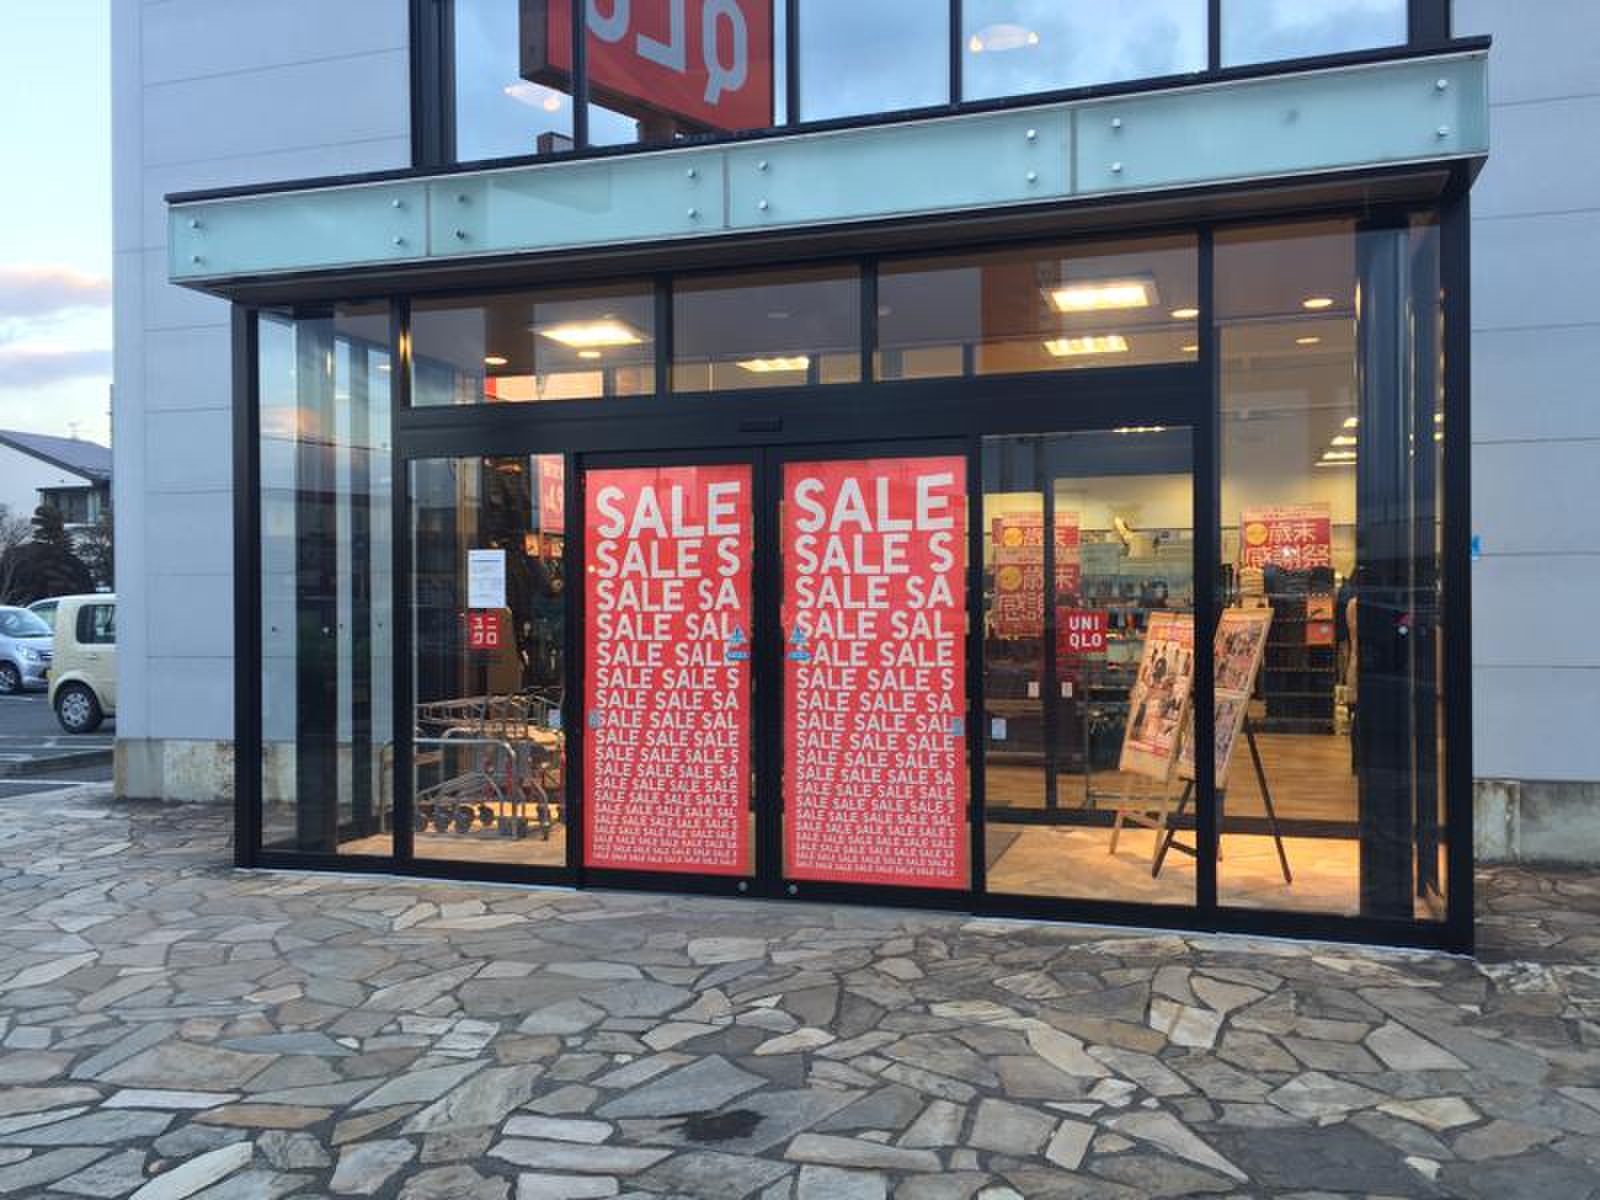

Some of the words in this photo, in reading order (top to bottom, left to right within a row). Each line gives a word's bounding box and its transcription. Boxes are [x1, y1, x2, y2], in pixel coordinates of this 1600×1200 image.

[596, 481, 739, 538] SALE
[795, 473, 953, 532] SALE
[595, 538, 701, 577] SALE
[717, 537, 740, 576] S
[795, 533, 909, 574] SALE
[929, 532, 953, 573] S
[596, 578, 684, 611] SALE
[698, 578, 740, 611] SA
[796, 575, 889, 608] SALE
[905, 575, 953, 608] SA
[596, 612, 672, 640] SALE
[685, 612, 737, 640] SAL
[797, 610, 877, 639] SALE
[891, 611, 953, 640] SAL
[1069, 615, 1099, 630] UNI
[1069, 632, 1102, 649] QLO
[597, 641, 663, 666] SALE
[880, 641, 953, 667] SALE
[596, 667, 652, 688] SALE
[662, 668, 716, 689] SALE
[726, 669, 738, 689] S
[797, 667, 856, 689] SALE
[867, 668, 930, 691] SALE
[941, 669, 953, 691] S
[595, 689, 646, 708] SALE
[655, 690, 703, 709] SALE
[711, 691, 737, 710] SA
[797, 690, 849, 710] SALE
[859, 691, 916, 712] SALE
[926, 692, 953, 713] SA
[650, 710, 694, 729] SALE
[702, 711, 737, 730] SAL
[797, 711, 844, 730] SALE
[854, 713, 907, 732] SALE
[916, 714, 952, 734] SAL
[595, 728, 639, 745] SALE
[646, 729, 688, 746] SALE
[693, 731, 738, 748] SALE
[797, 731, 841, 749] SALE
[849, 732, 897, 750] SALE
[906, 734, 954, 752] SALE
[595, 745, 633, 760] SALE
[640, 747, 678, 762] SALE
[686, 748, 724, 763] SALE
[729, 750, 737, 764] S
[797, 749, 837, 766] SALE
[845, 751, 888, 768] SALE
[895, 753, 939, 770] SALE
[946, 755, 954, 770] S
[595, 761, 631, 776] SALE
[636, 762, 673, 777] SALE
[680, 764, 714, 779] SALE
[720, 765, 736, 780] SA
[796, 765, 834, 781] SALE
[840, 767, 880, 783] SALE
[887, 769, 928, 785] SALE
[934, 771, 954, 786] SA
[594, 776, 627, 788] SALE
[632, 777, 664, 789] SALE
[671, 779, 700, 791] SALE
[705, 780, 736, 792] SALE
[796, 781, 831, 795] SALE
[836, 783, 872, 797] SALE
[878, 785, 912, 799] SALE
[919, 787, 954, 801] SALE
